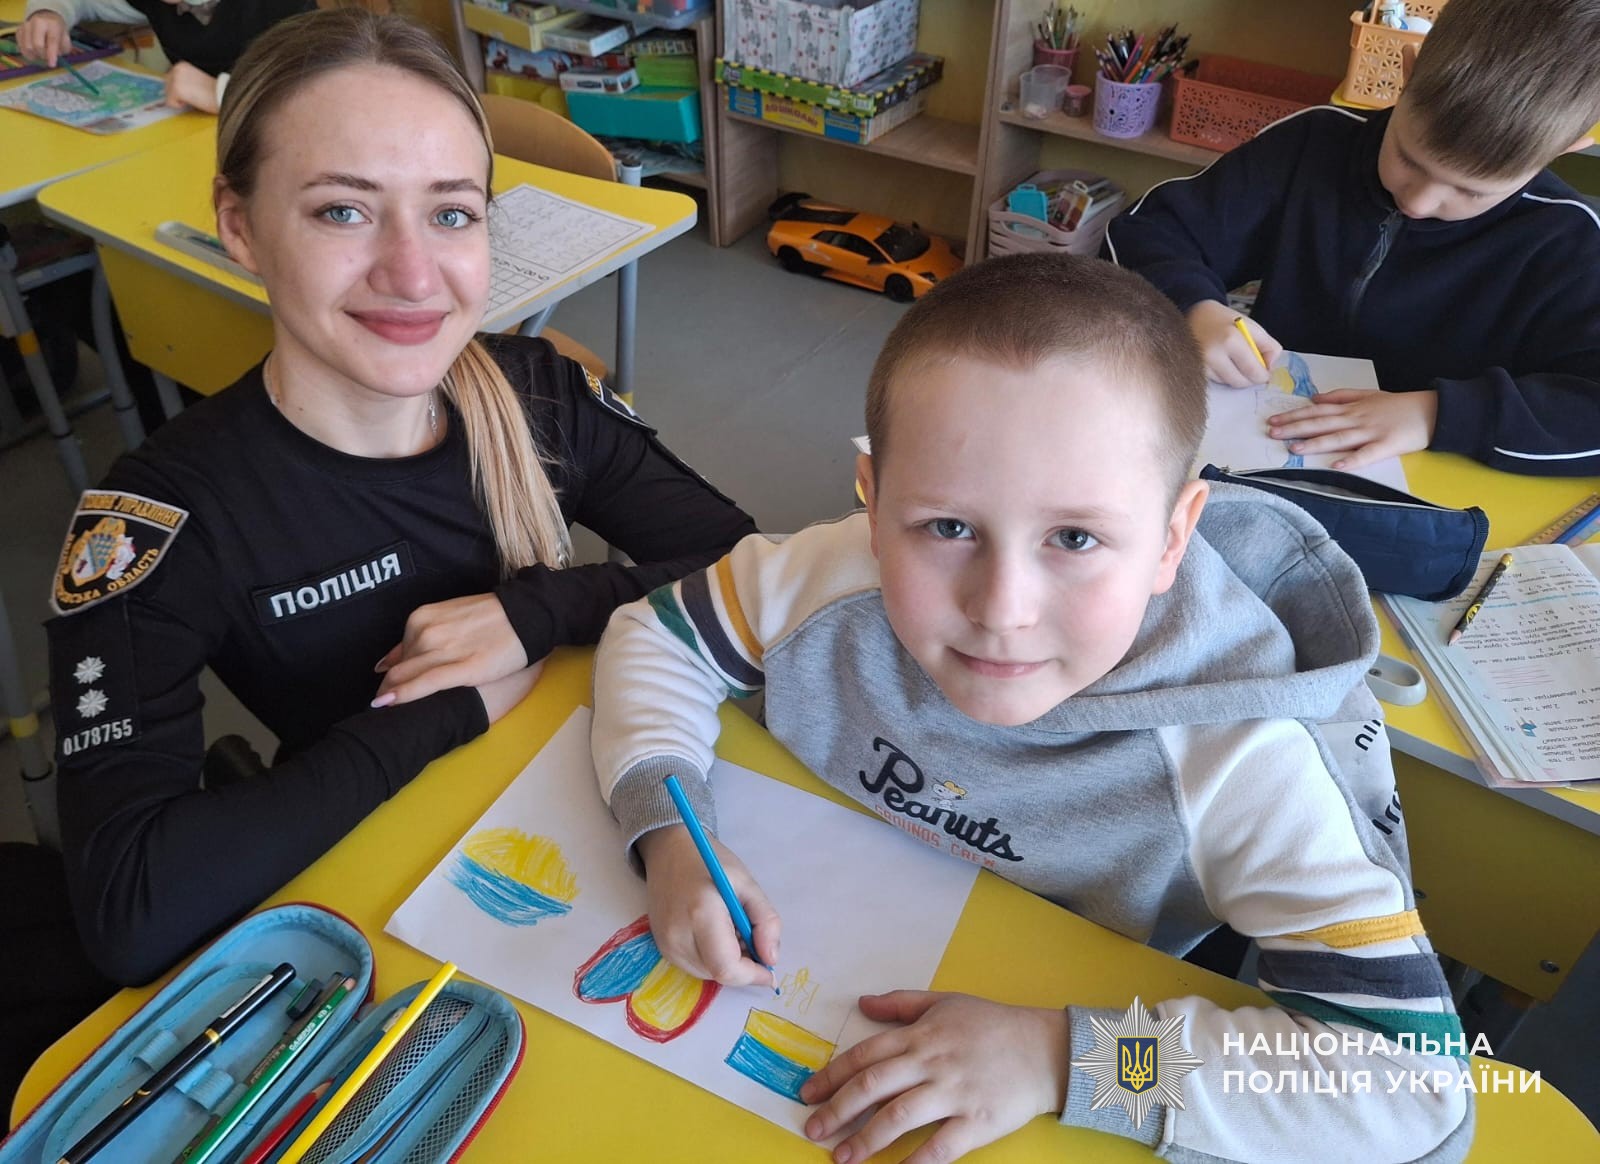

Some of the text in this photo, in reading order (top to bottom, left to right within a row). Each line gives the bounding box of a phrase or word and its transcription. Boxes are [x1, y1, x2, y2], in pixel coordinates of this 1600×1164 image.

[107, 547, 160, 593] ОБЛАСТЬ
[270, 552, 402, 618] ПОЛІЦІЯ
[63, 718, 133, 756] 0178755
[859, 736, 1024, 862] Peanuts
[951, 842, 997, 869] CREW
